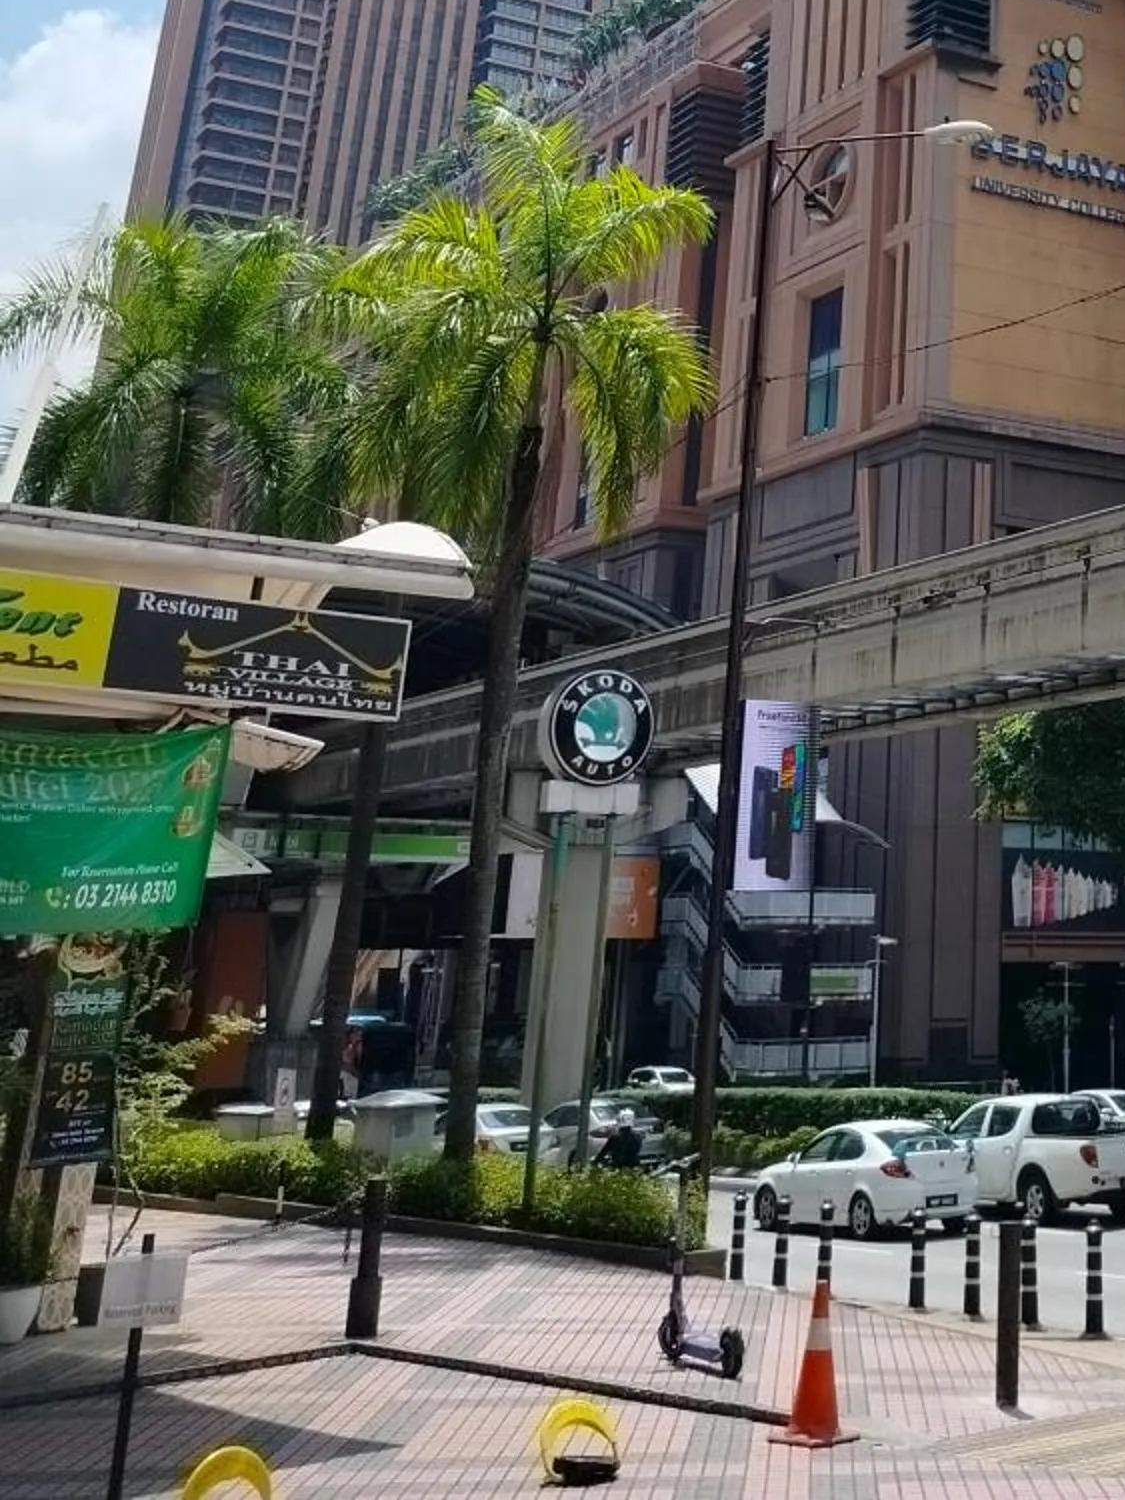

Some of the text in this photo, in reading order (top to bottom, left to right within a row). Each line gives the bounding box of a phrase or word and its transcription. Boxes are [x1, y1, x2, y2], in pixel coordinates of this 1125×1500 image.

[971, 176, 1060, 209] UNIVERSITY
[136, 591, 239, 622] Restoran
[233, 651, 350, 677] THAI
[225, 666, 355, 691] VILLAGE
[570, 755, 633, 775] AUTO
[75, 879, 178, 909] 03 2144 8310
[62, 1061, 93, 1084] 85
[55, 1089, 90, 1113] 42
